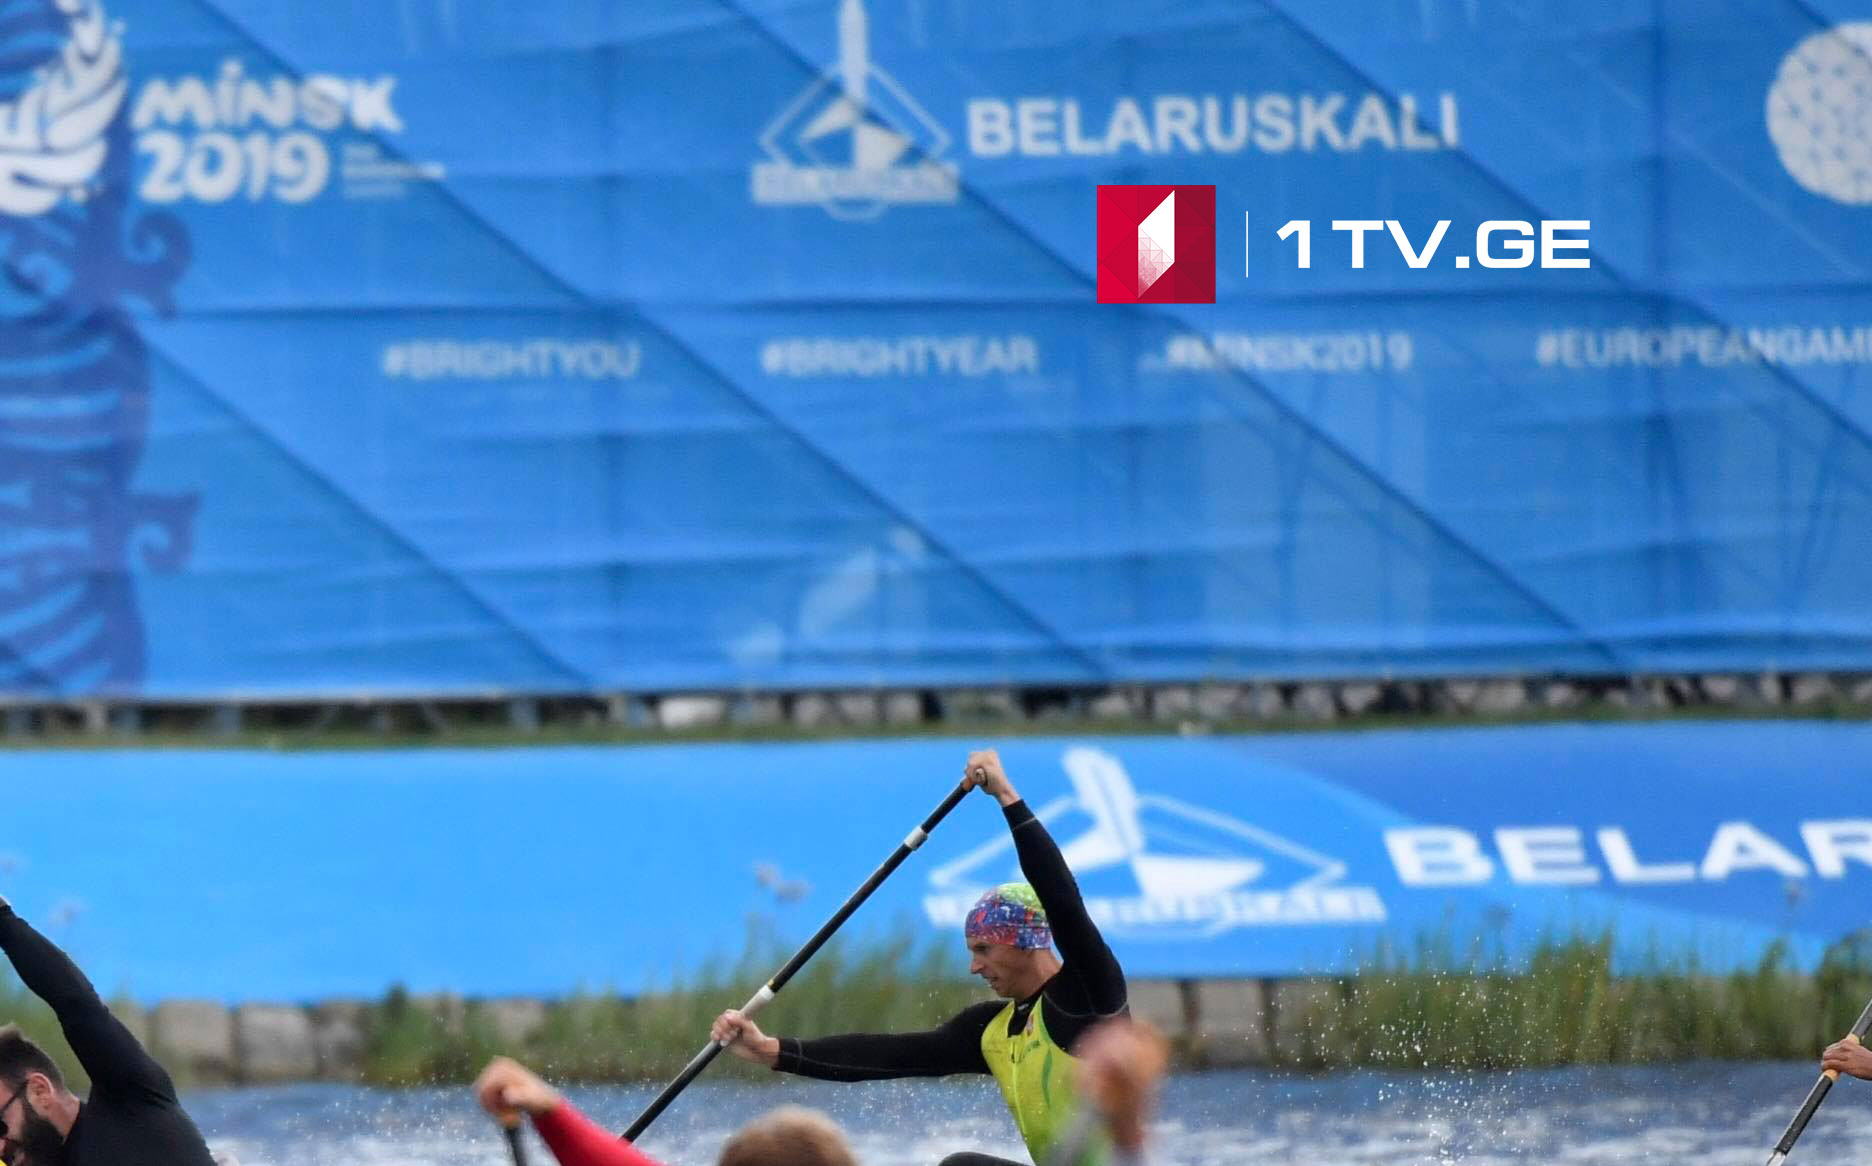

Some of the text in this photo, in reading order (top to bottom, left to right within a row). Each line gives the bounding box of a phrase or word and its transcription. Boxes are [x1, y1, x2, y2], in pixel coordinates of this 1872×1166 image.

[968, 92, 1459, 158] BELARUSKALI
[135, 132, 330, 203] 2019
[384, 340, 640, 378] #BRIGHTYOU
[760, 336, 1037, 377] #BRIGHTYEAR
[1537, 327, 1872, 368] #EUROPEANGAM
